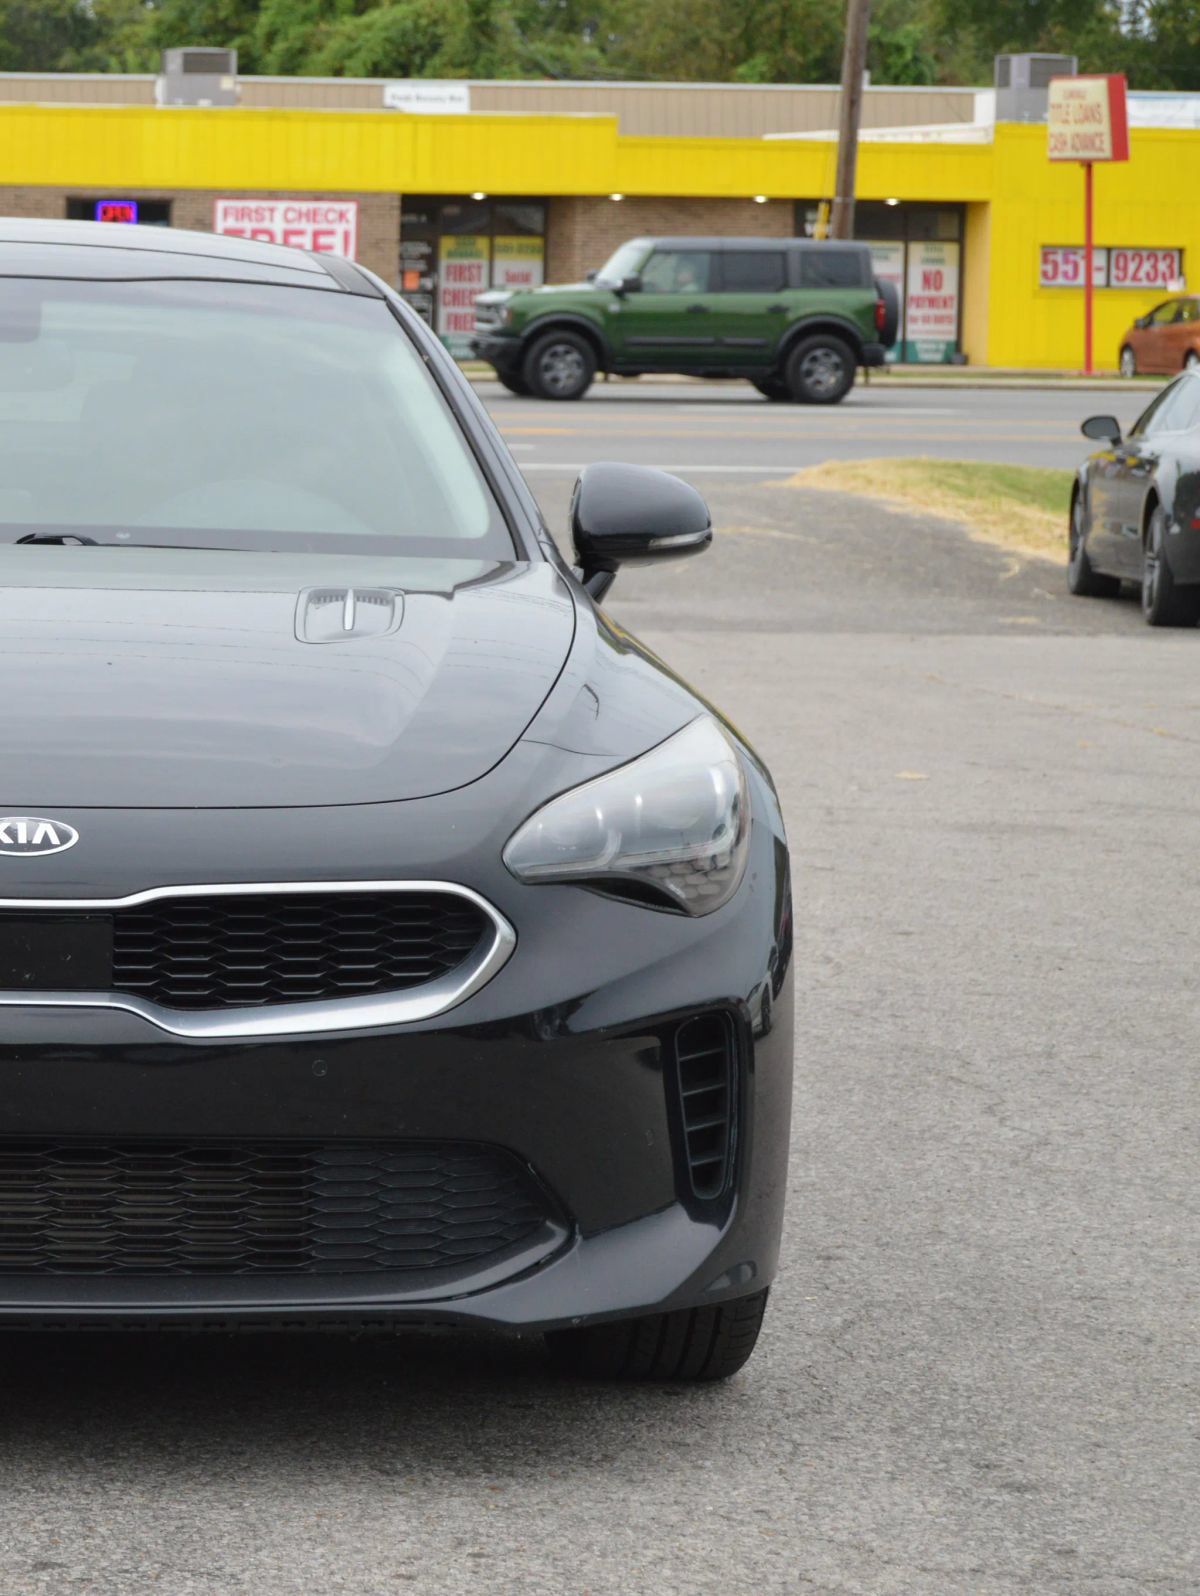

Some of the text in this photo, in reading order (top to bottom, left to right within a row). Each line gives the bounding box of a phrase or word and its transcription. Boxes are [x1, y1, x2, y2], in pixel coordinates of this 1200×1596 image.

[223, 206, 351, 224] FIRST CHECK
[446, 263, 483, 283] FIRST
[1041, 250, 1176, 283] 55-9233
[922, 270, 944, 292] NO
[442, 288, 484, 307] CHEC
[908, 296, 954, 309] PAYMENT
